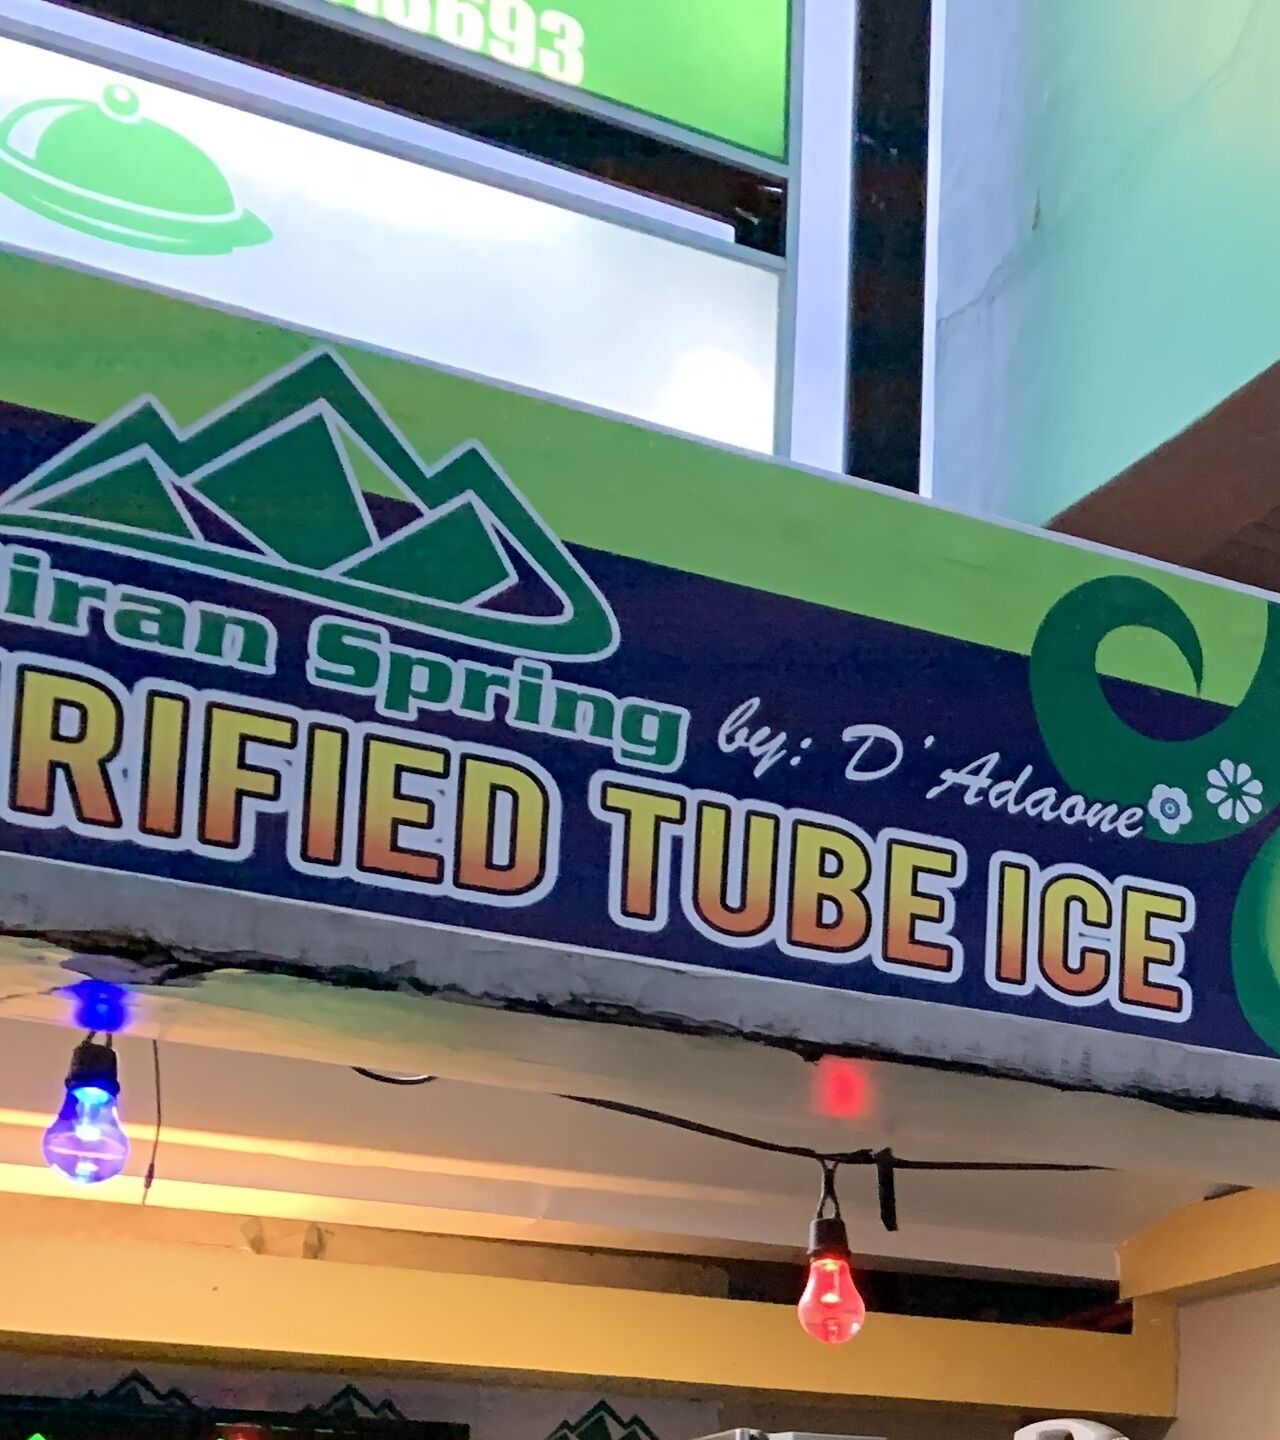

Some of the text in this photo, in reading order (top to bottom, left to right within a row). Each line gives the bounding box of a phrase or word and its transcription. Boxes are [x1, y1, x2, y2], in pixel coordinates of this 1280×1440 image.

[307, 615, 688, 772] Spring
[717, 697, 814, 778] by:
[596, 776, 964, 978] TUBE
[991, 857, 1194, 1016] ICE
